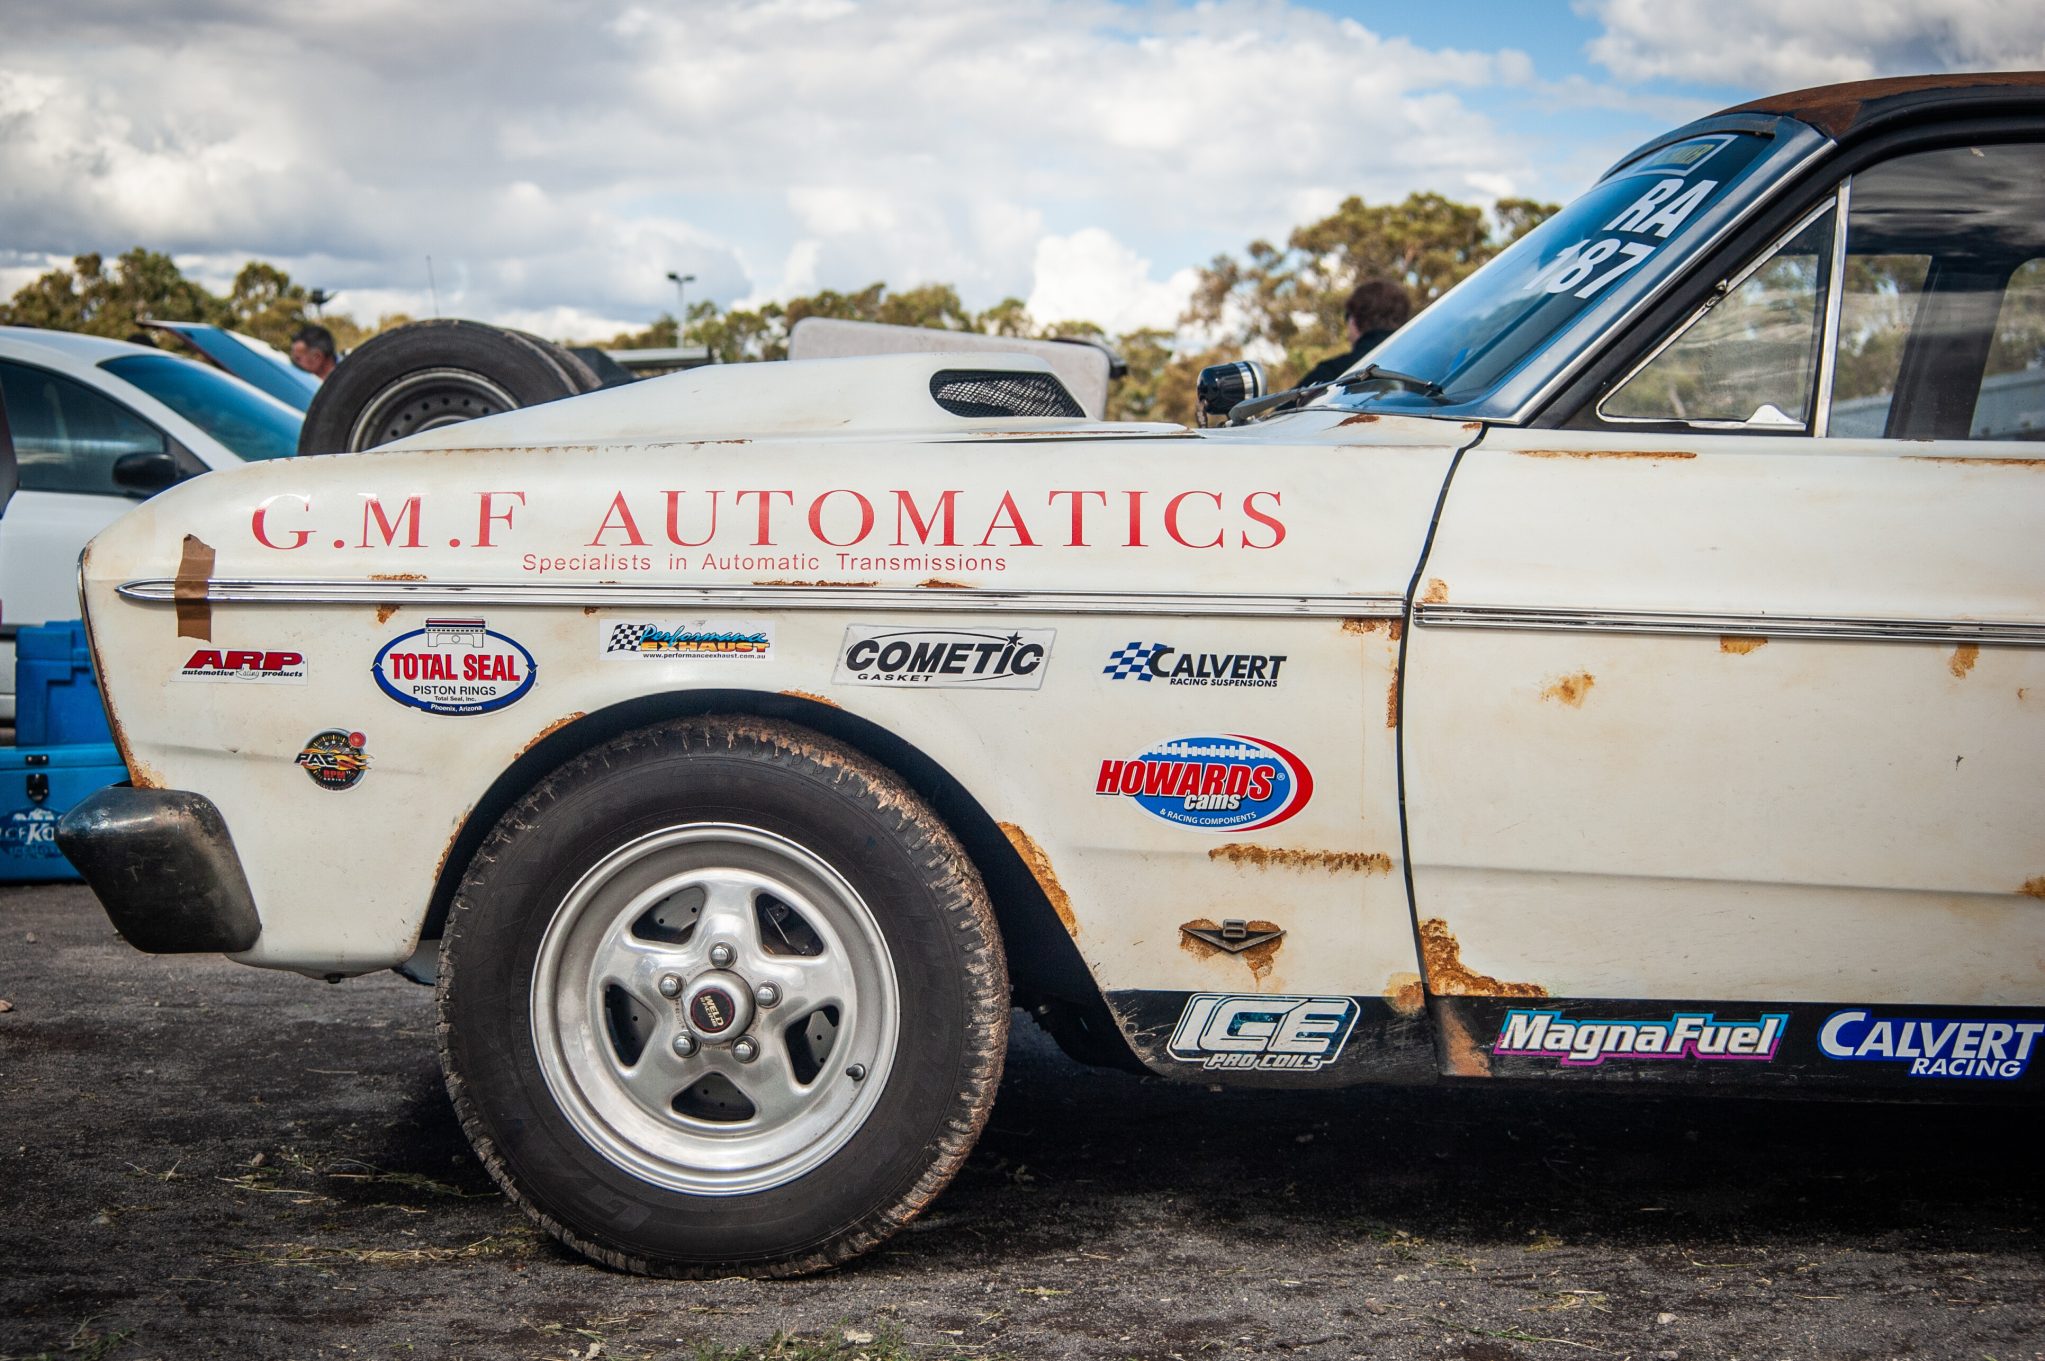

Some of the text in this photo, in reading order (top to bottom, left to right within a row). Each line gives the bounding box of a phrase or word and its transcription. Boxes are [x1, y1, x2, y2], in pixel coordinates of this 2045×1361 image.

[1602, 178, 1718, 238] RA
[1522, 238, 1656, 300] 187
[584, 489, 1287, 549] AUTOMATICS
[522, 553, 1006, 574] Specialists in Automatic Transmissions
[641, 641, 770, 652] EXHAUST
[846, 639, 1044, 675] COMETIC
[184, 650, 303, 671] ARP
[390, 653, 520, 681] TOTAL SEAL
[1149, 647, 1287, 679] CALVERT
[857, 673, 933, 682] GASKET
[1170, 678, 1278, 687] RACING SUSPENSIONS
[413, 685, 496, 695] PISTON RINGS
[431, 704, 457, 712] Phoenix,
[1096, 759, 1275, 801] HOWARDS
[1183, 793, 1242, 811] cams
[1167, 810, 1198, 824] RACING
[1200, 811, 1257, 825] COMPONENTS
[704, 995, 724, 1026] WELD
[1498, 1012, 1782, 1061] MagnaFuel
[1820, 1011, 2045, 1060] CALVERT
[1258, 1054, 1322, 1068] COILS
[1911, 1058, 2021, 1078] RACING
